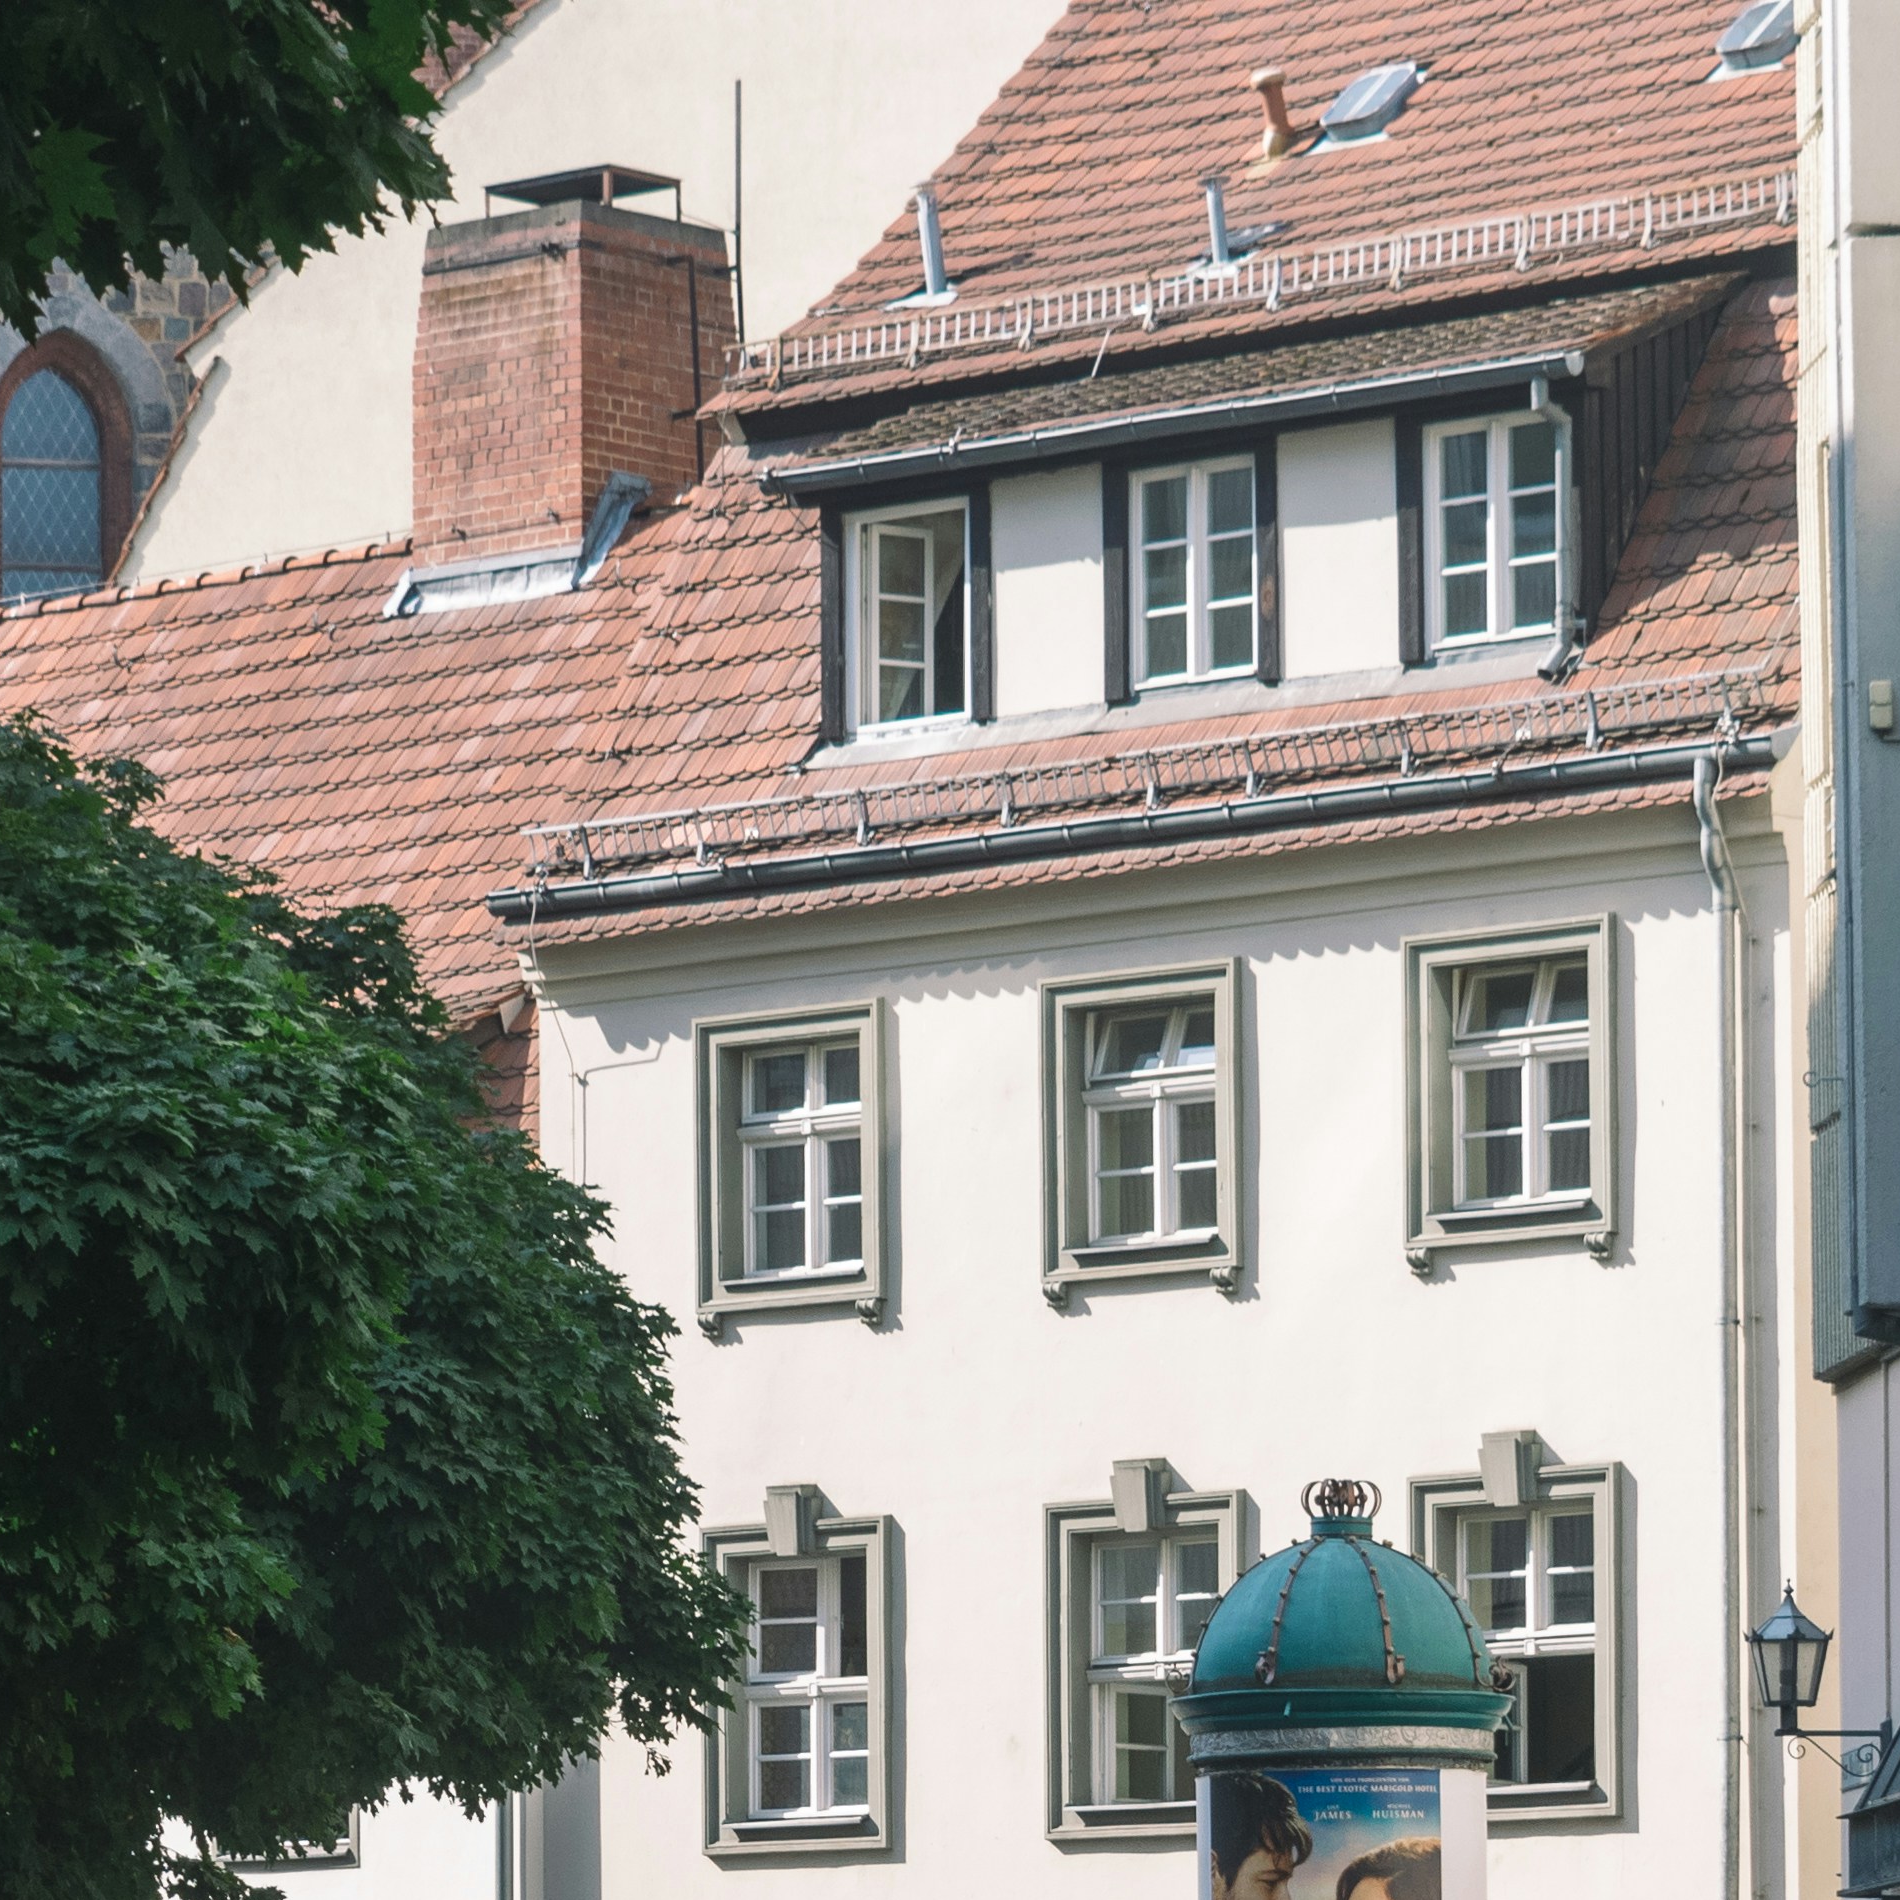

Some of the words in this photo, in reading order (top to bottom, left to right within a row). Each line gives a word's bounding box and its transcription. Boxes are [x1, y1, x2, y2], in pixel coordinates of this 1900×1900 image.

[1316, 1785, 1335, 1793] BEST
[1338, 1785, 1368, 1793] EXOTIC
[1370, 1785, 1412, 1793] MARIGOLD
[1415, 1785, 1438, 1793] HOTEL
[1314, 1810, 1352, 1820] JAMES
[1372, 1810, 1424, 1819] HUISMAN
